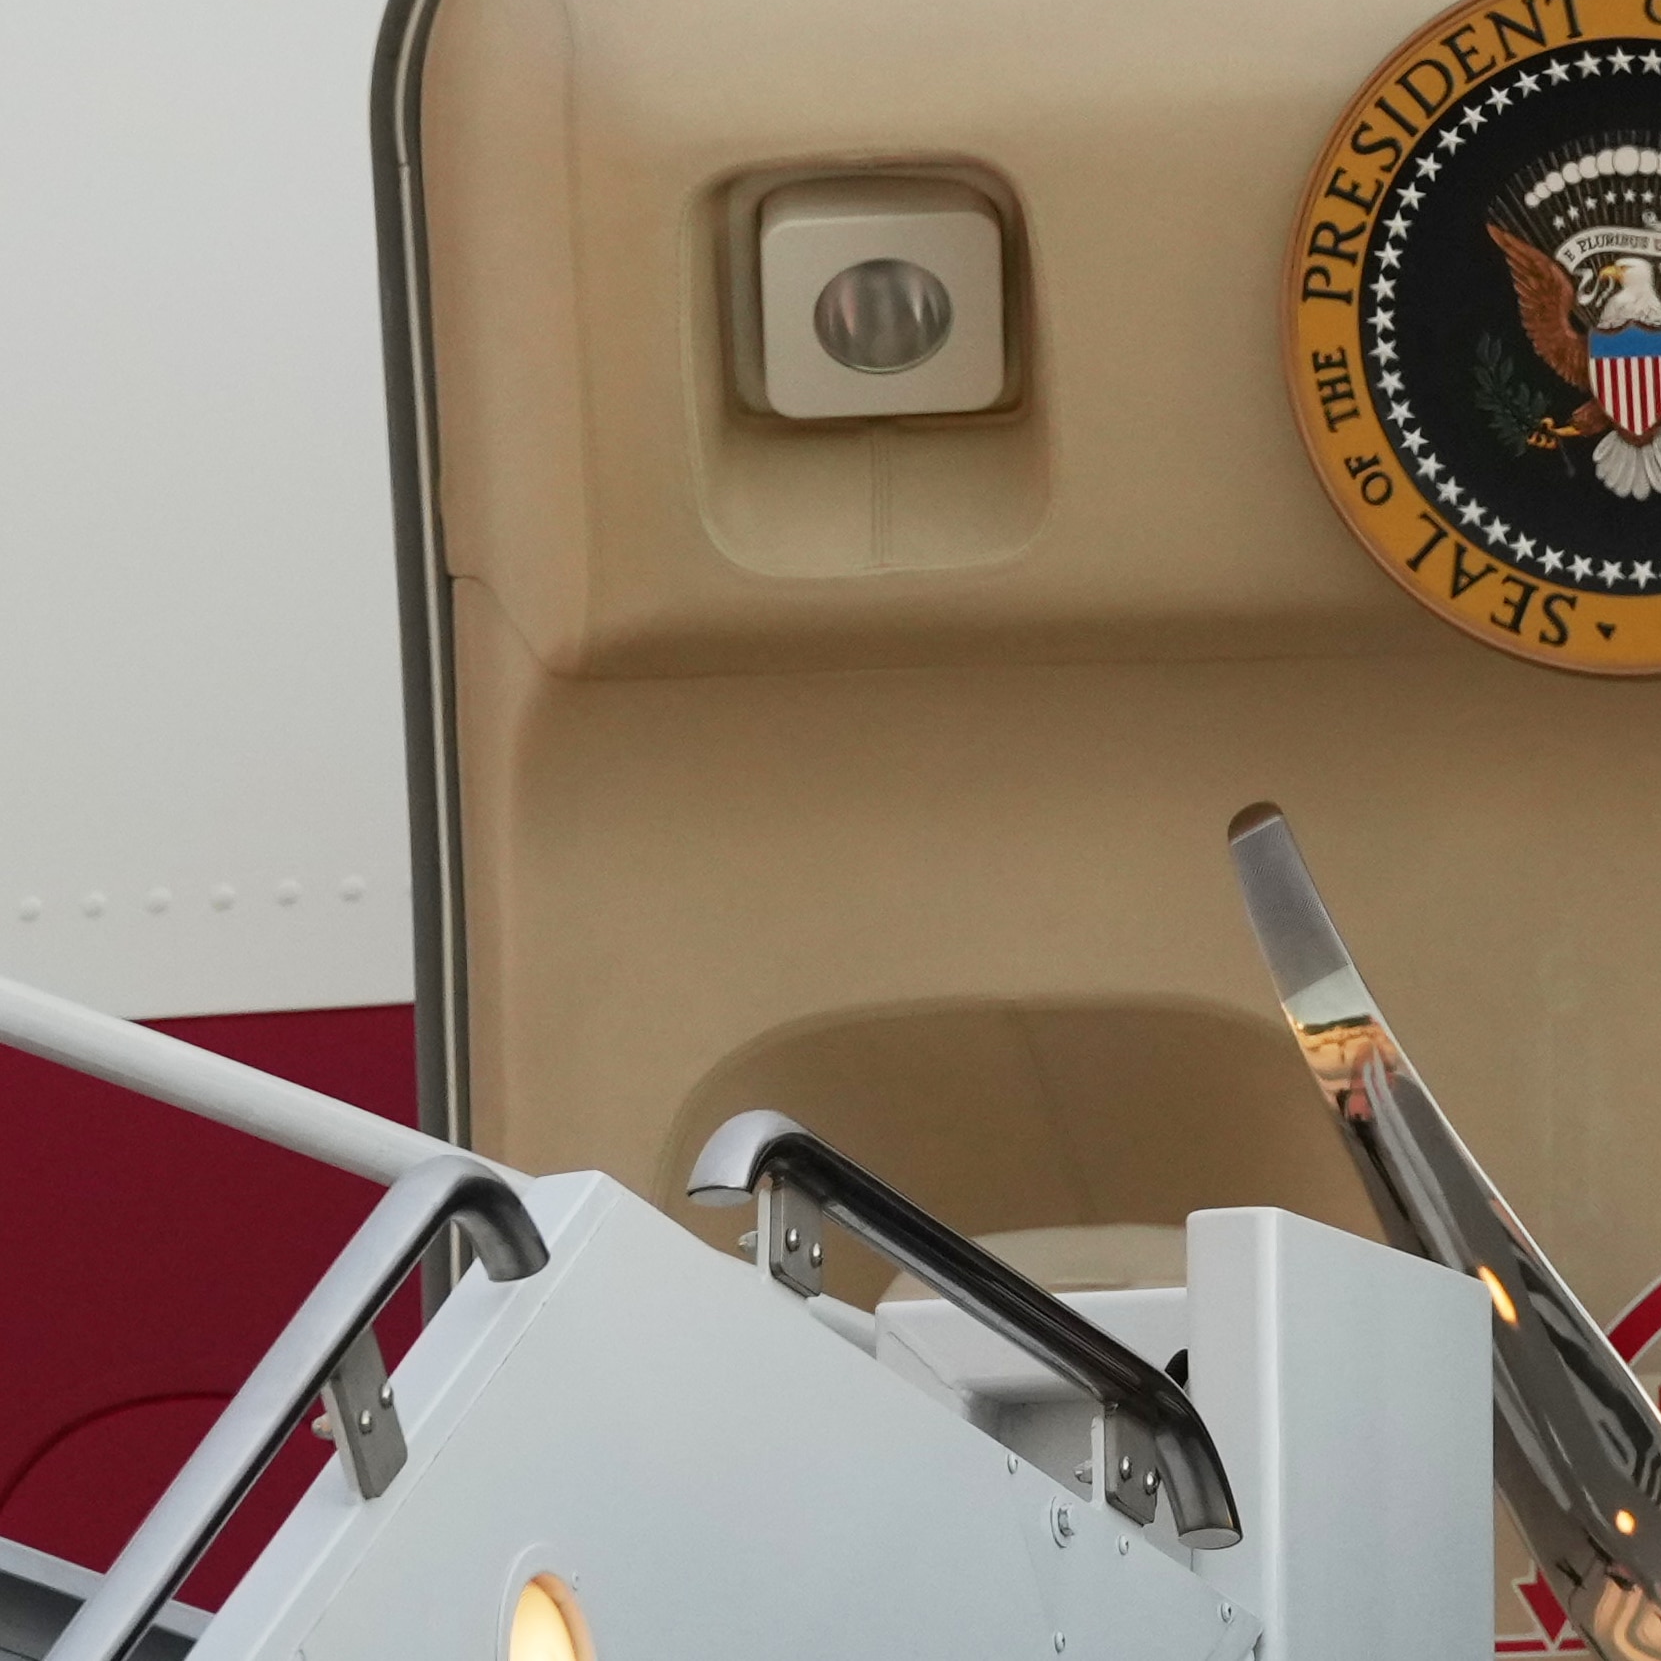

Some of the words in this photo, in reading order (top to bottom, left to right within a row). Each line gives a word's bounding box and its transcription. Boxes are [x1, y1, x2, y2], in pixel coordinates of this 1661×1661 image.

[1564, 249, 1575, 263] E
[1577, 233, 1649, 255] PLURIBUS
[1311, 347, 1361, 433] THE
[1343, 453, 1394, 507] OF
[1405, 513, 1579, 647] SEAL
